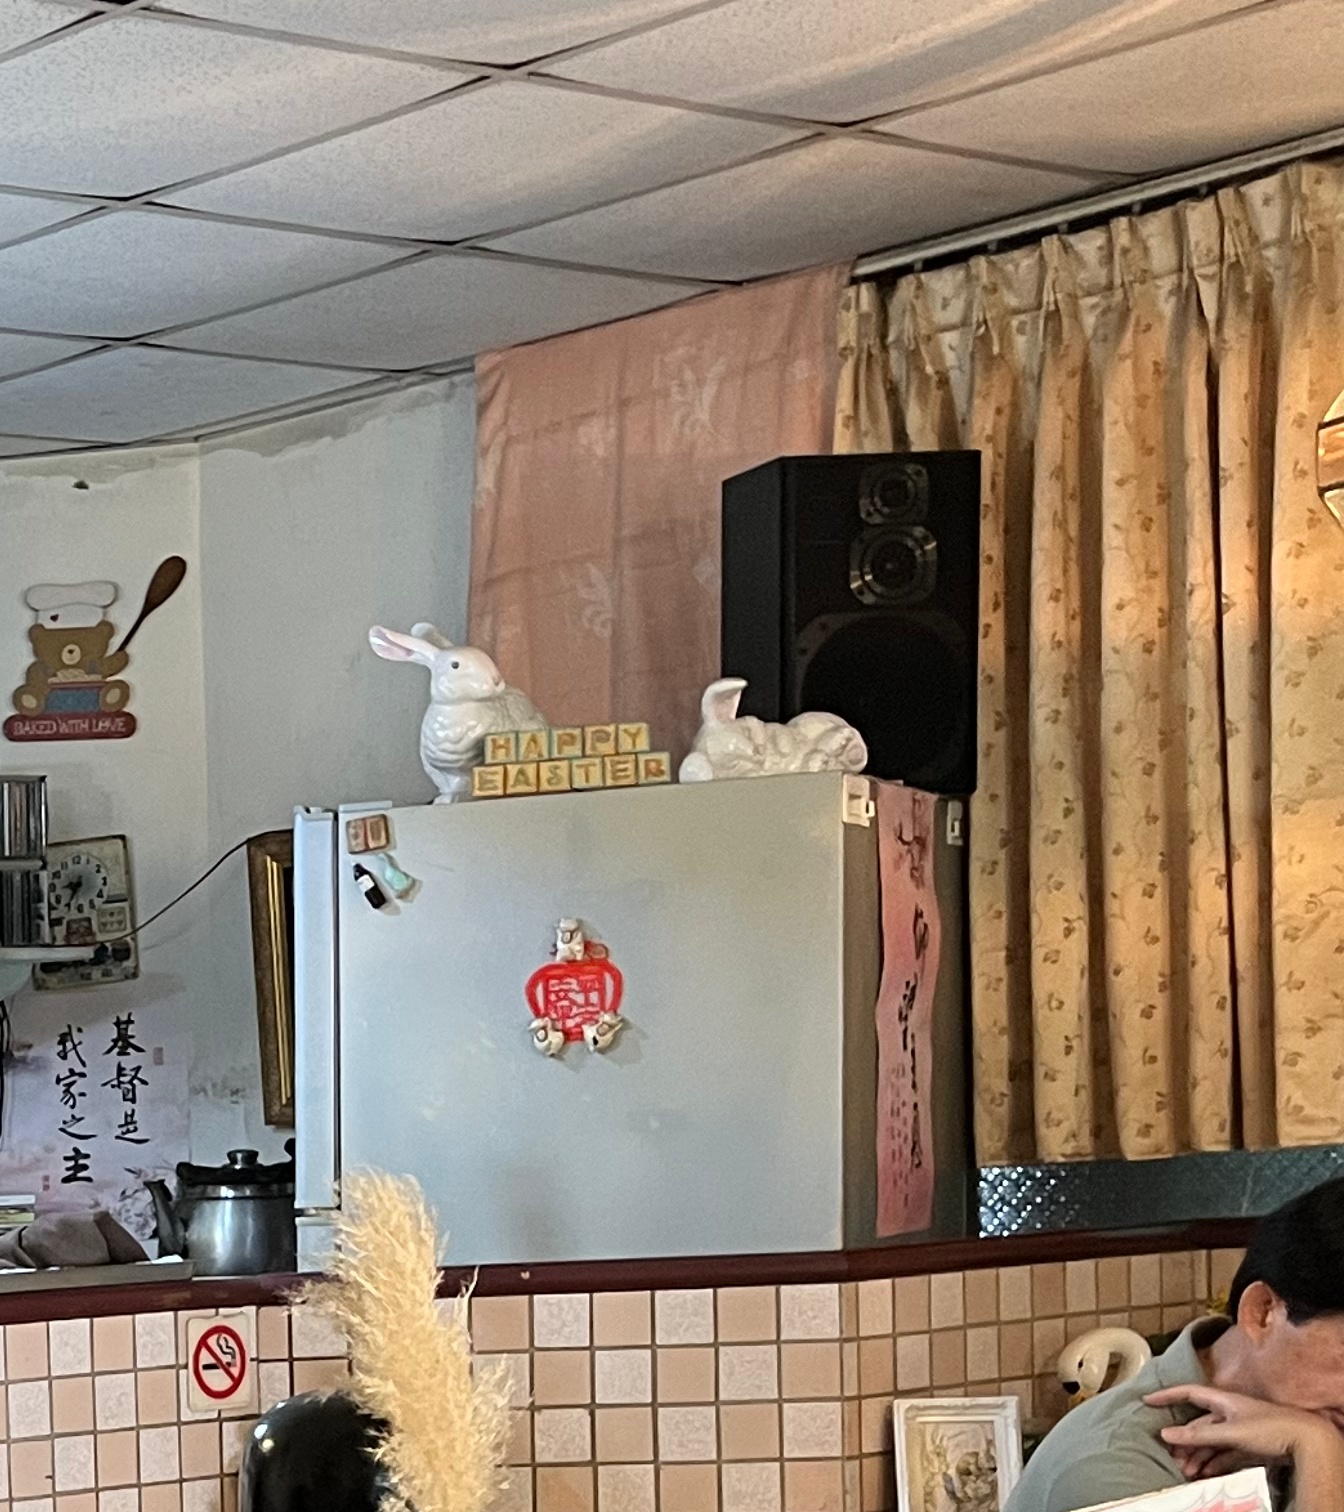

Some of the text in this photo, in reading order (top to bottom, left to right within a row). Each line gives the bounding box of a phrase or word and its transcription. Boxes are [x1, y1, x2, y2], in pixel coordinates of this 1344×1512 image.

[13, 717, 126, 735] BAKED WITH LOVE
[490, 728, 643, 761] HAPPY
[476, 758, 666, 793] EASTER
[101, 1012, 150, 1144] 基督是
[55, 1024, 97, 1184] 我家之主
